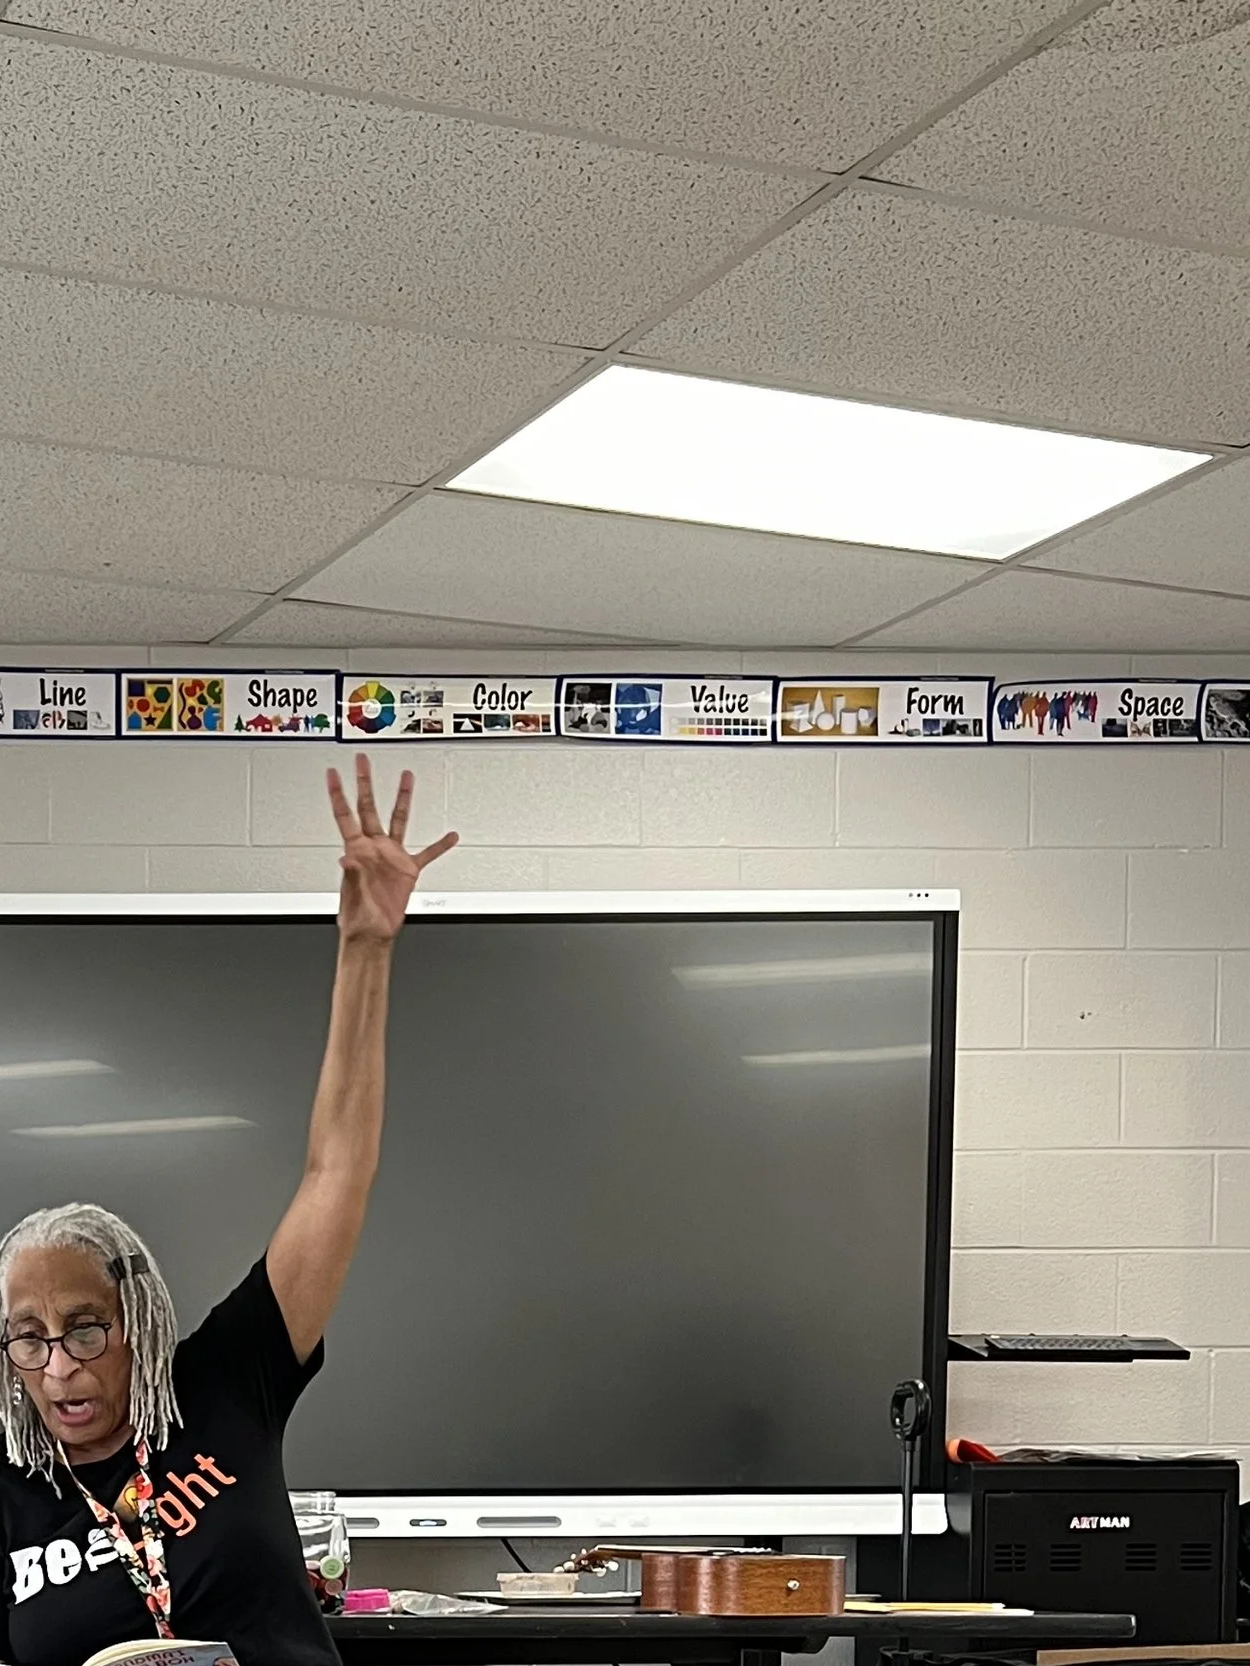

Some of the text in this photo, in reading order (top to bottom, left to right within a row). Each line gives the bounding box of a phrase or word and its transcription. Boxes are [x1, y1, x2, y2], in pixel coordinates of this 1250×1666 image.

[40, 678, 86, 706] Line
[248, 679, 318, 713] Shape
[473, 683, 533, 710] Color
[690, 685, 749, 713] Value
[907, 687, 964, 715] Form
[1118, 688, 1184, 722] Space
[134, 1453, 237, 1551] ght
